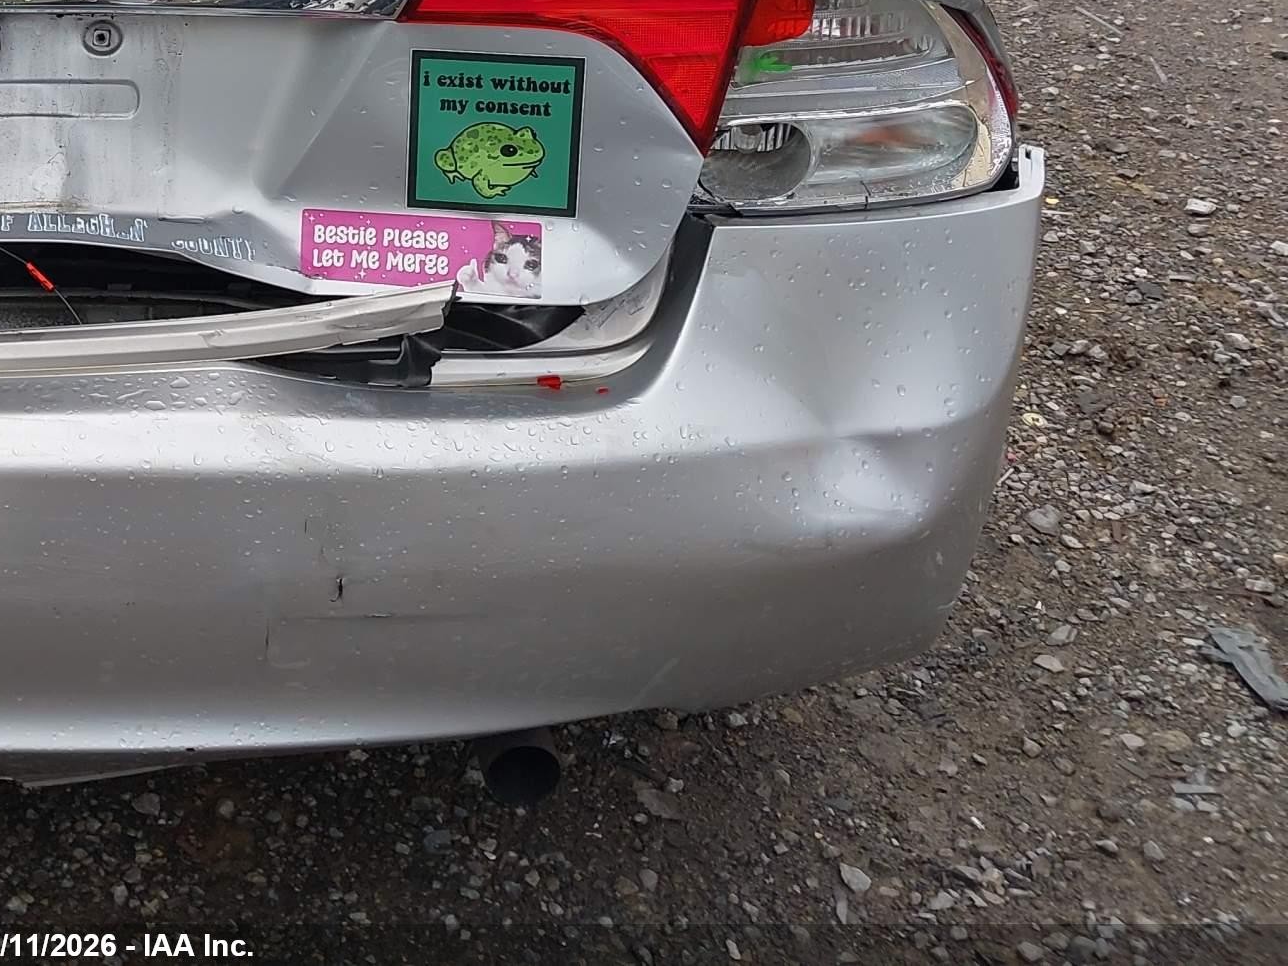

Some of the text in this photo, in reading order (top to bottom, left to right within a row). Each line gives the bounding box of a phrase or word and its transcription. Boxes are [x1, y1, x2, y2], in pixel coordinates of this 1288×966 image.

[423, 71, 571, 94] i exist without
[440, 97, 552, 117] my consent
[27, 212, 148, 242] ALLEGHN
[313, 224, 449, 251] Bestie Please
[312, 249, 449, 276] Let Me Merge
